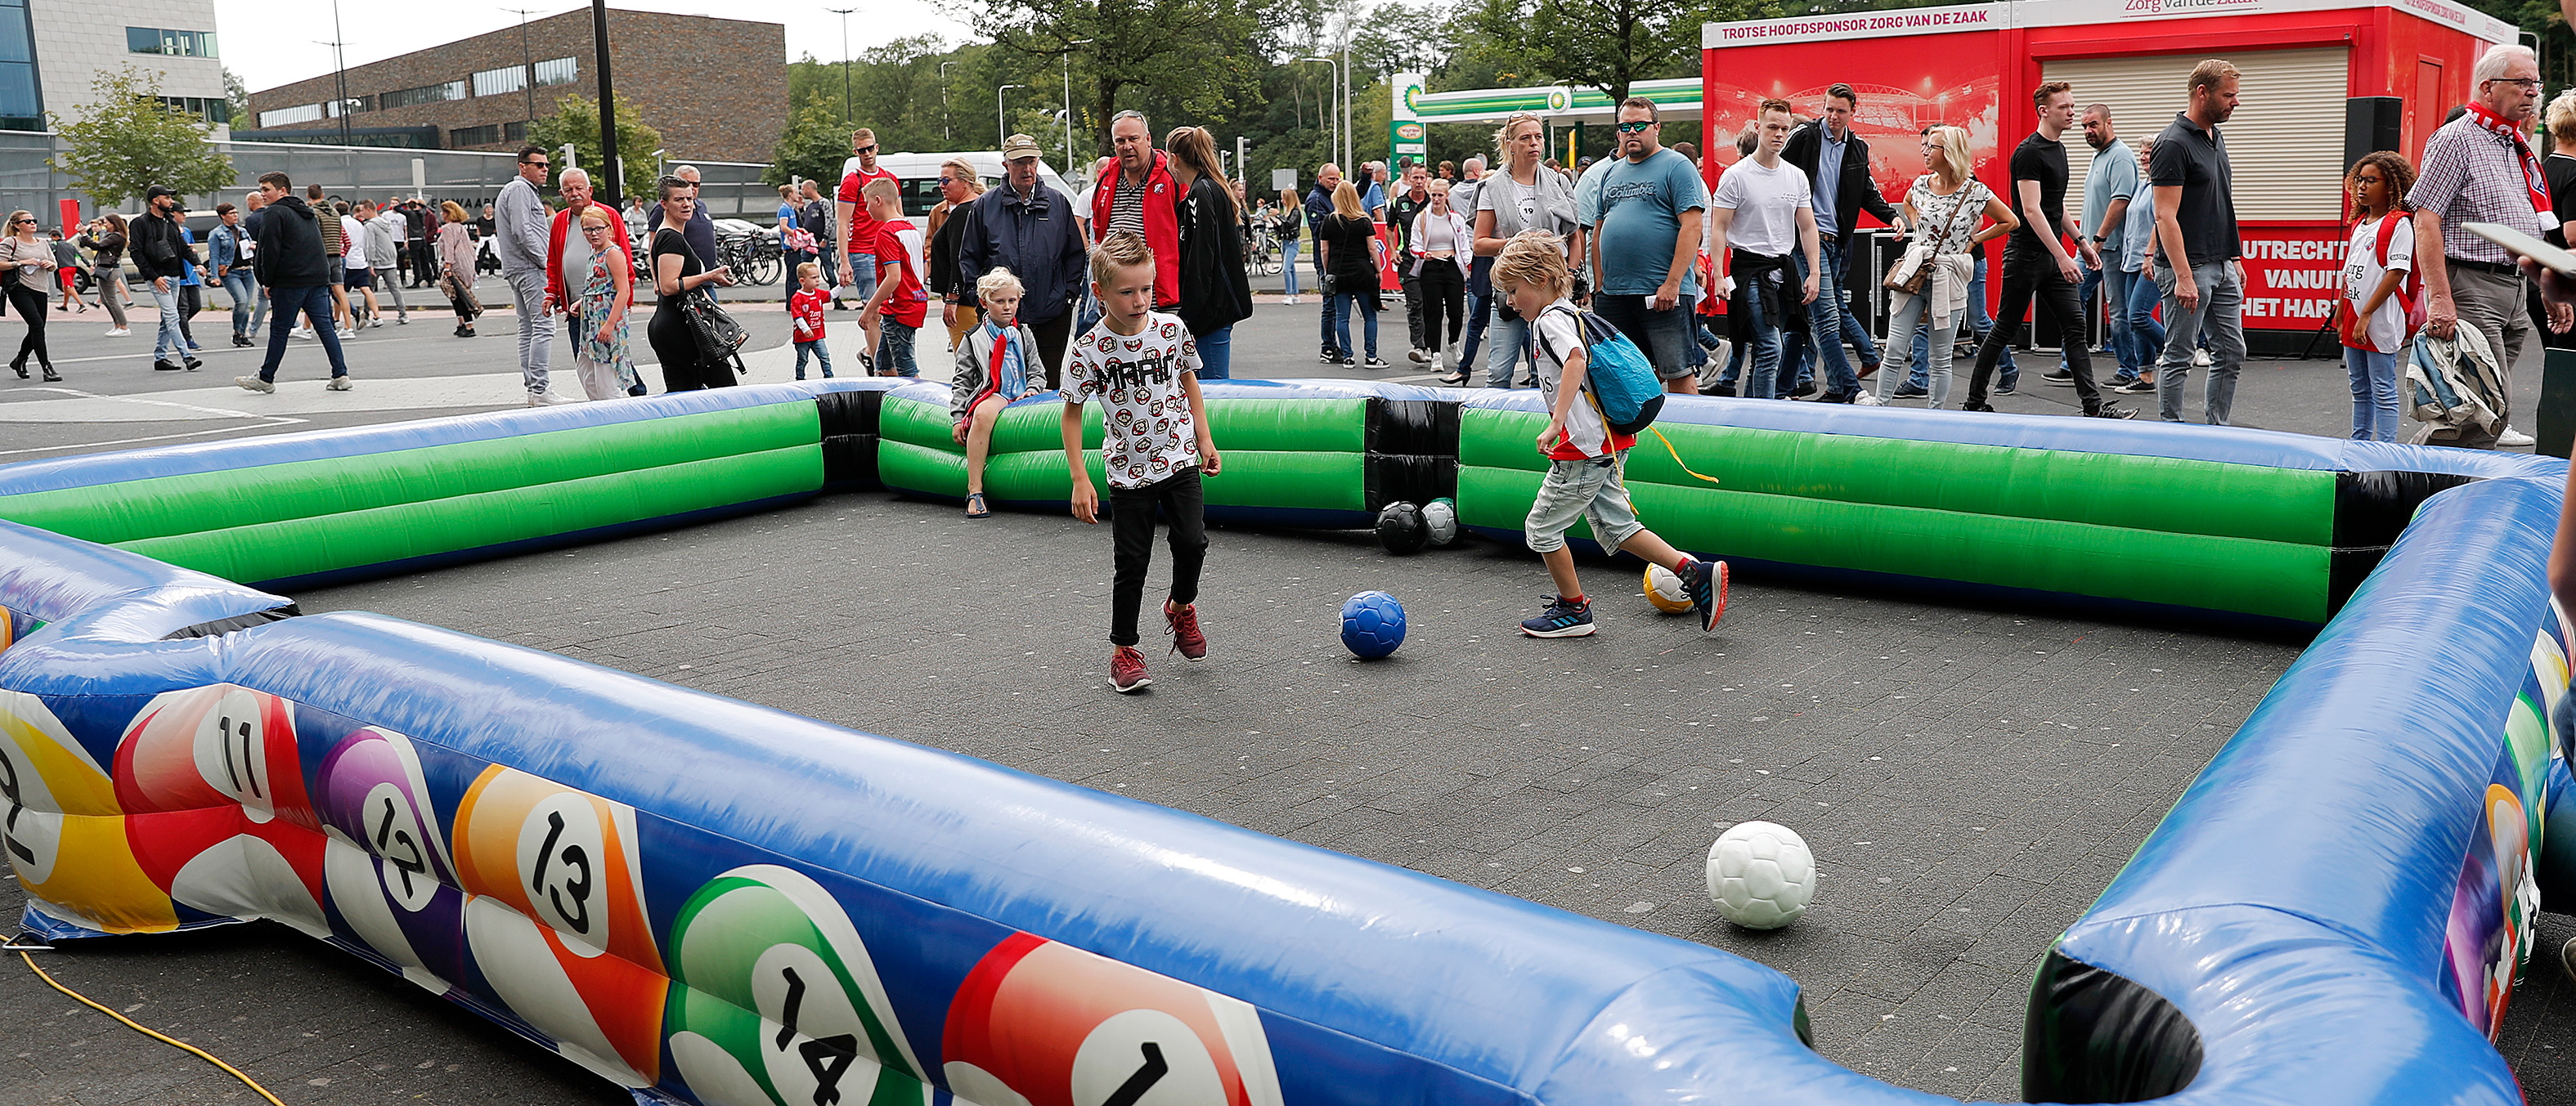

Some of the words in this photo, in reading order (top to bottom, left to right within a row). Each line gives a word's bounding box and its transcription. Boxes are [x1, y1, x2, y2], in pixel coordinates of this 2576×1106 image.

[2125, 0, 2161, 12] Zorg
[1722, 26, 1766, 39] TROTSE
[1769, 20, 1867, 37] HOOFDSPONSOR
[1870, 16, 1903, 29] ZORG
[1905, 14, 1931, 27] VAN
[1934, 12, 1950, 25] DE
[1954, 10, 1989, 25] ZAAK
[1608, 183, 1654, 198] Columbia
[2242, 240, 2349, 260] UTRECHT
[2264, 269, 2345, 289] VANUIT
[2240, 298, 2281, 317] HET
[2283, 298, 2339, 318] HAR
[219, 716, 263, 799] 11
[376, 796, 426, 901] 12
[532, 810, 592, 935] 13
[776, 966, 858, 1106] 14
